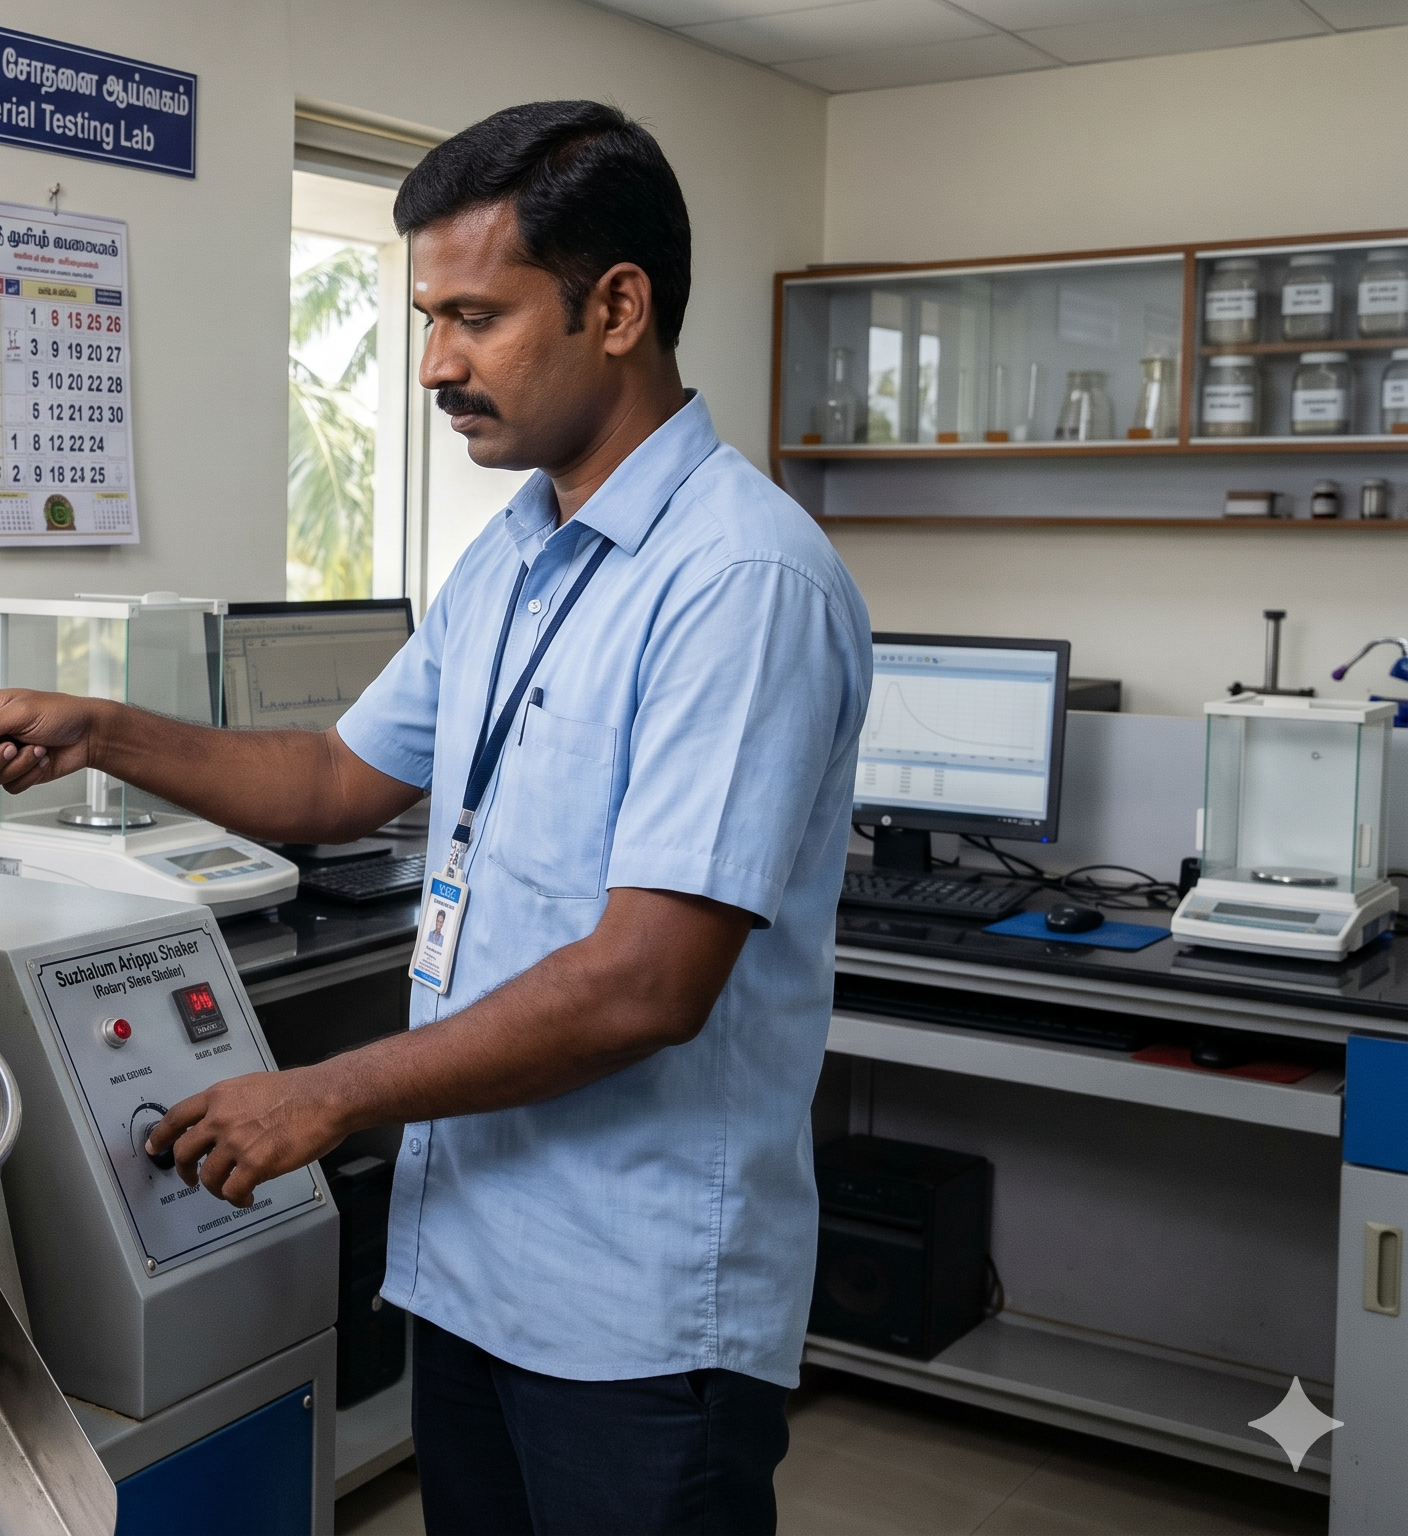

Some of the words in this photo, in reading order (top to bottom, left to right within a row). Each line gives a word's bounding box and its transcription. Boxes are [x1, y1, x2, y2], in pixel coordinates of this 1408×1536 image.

[2, 48, 98, 96] சோதனை
[103, 73, 189, 115] ஆய்வகம்
[42, 104, 113, 150] Testing
[120, 120, 154, 151] Lab
[30, 308, 36, 324] 1
[67, 311, 82, 329] 15
[106, 315, 121, 333] 26
[30, 338, 38, 356] 3
[51, 341, 59, 358] 9
[67, 342, 82, 360] 19
[87, 344, 102, 361] 20
[106, 346, 121, 363] 27
[32, 371, 39, 388] 5
[48, 372, 63, 390] 10
[67, 374, 83, 391] 20
[87, 375, 103, 392] 22
[107, 376, 123, 393] 28
[48, 403, 64, 421] 12
[68, 404, 82, 421] 21
[88, 406, 103, 422] 23
[108, 406, 123, 423] 30
[11, 433, 18, 450] 1
[33, 434, 41, 451] 8
[48, 435, 64, 451] 12
[69, 435, 85, 452] 22
[89, 436, 104, 452] 24
[12, 465, 21, 482] 2
[34, 465, 42, 483] 9
[49, 466, 65, 483] 18
[90, 467, 105, 484] 25
[55, 959, 118, 988] Suzhalum
[118, 950, 159, 972] Arippu
[158, 940, 199, 961] Shaker
[93, 981, 126, 999] (Rotary
